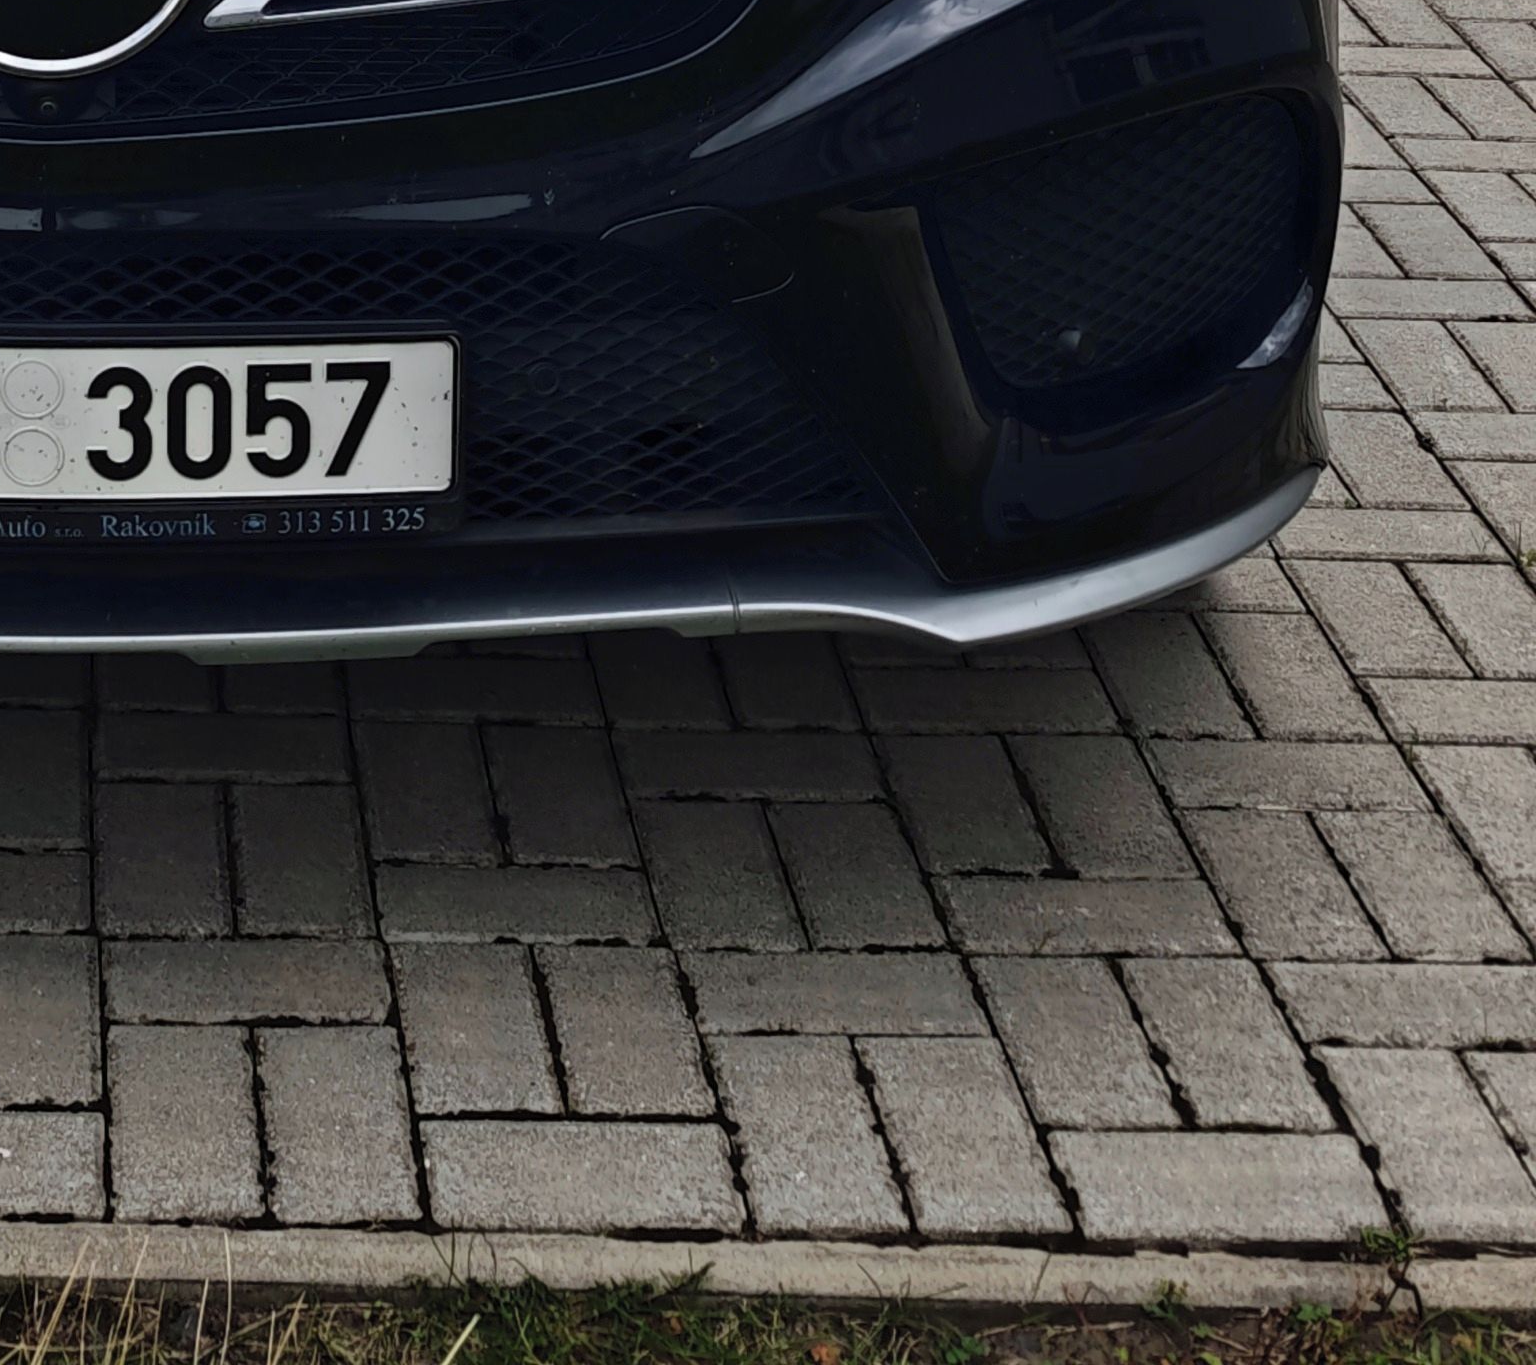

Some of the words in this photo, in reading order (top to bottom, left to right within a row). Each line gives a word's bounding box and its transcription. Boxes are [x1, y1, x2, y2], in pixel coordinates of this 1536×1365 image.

[86, 360, 392, 482] 3057
[100, 513, 216, 538] Rakovník
[277, 511, 321, 534] 313
[330, 509, 371, 533] 511
[381, 507, 425, 532] 325
